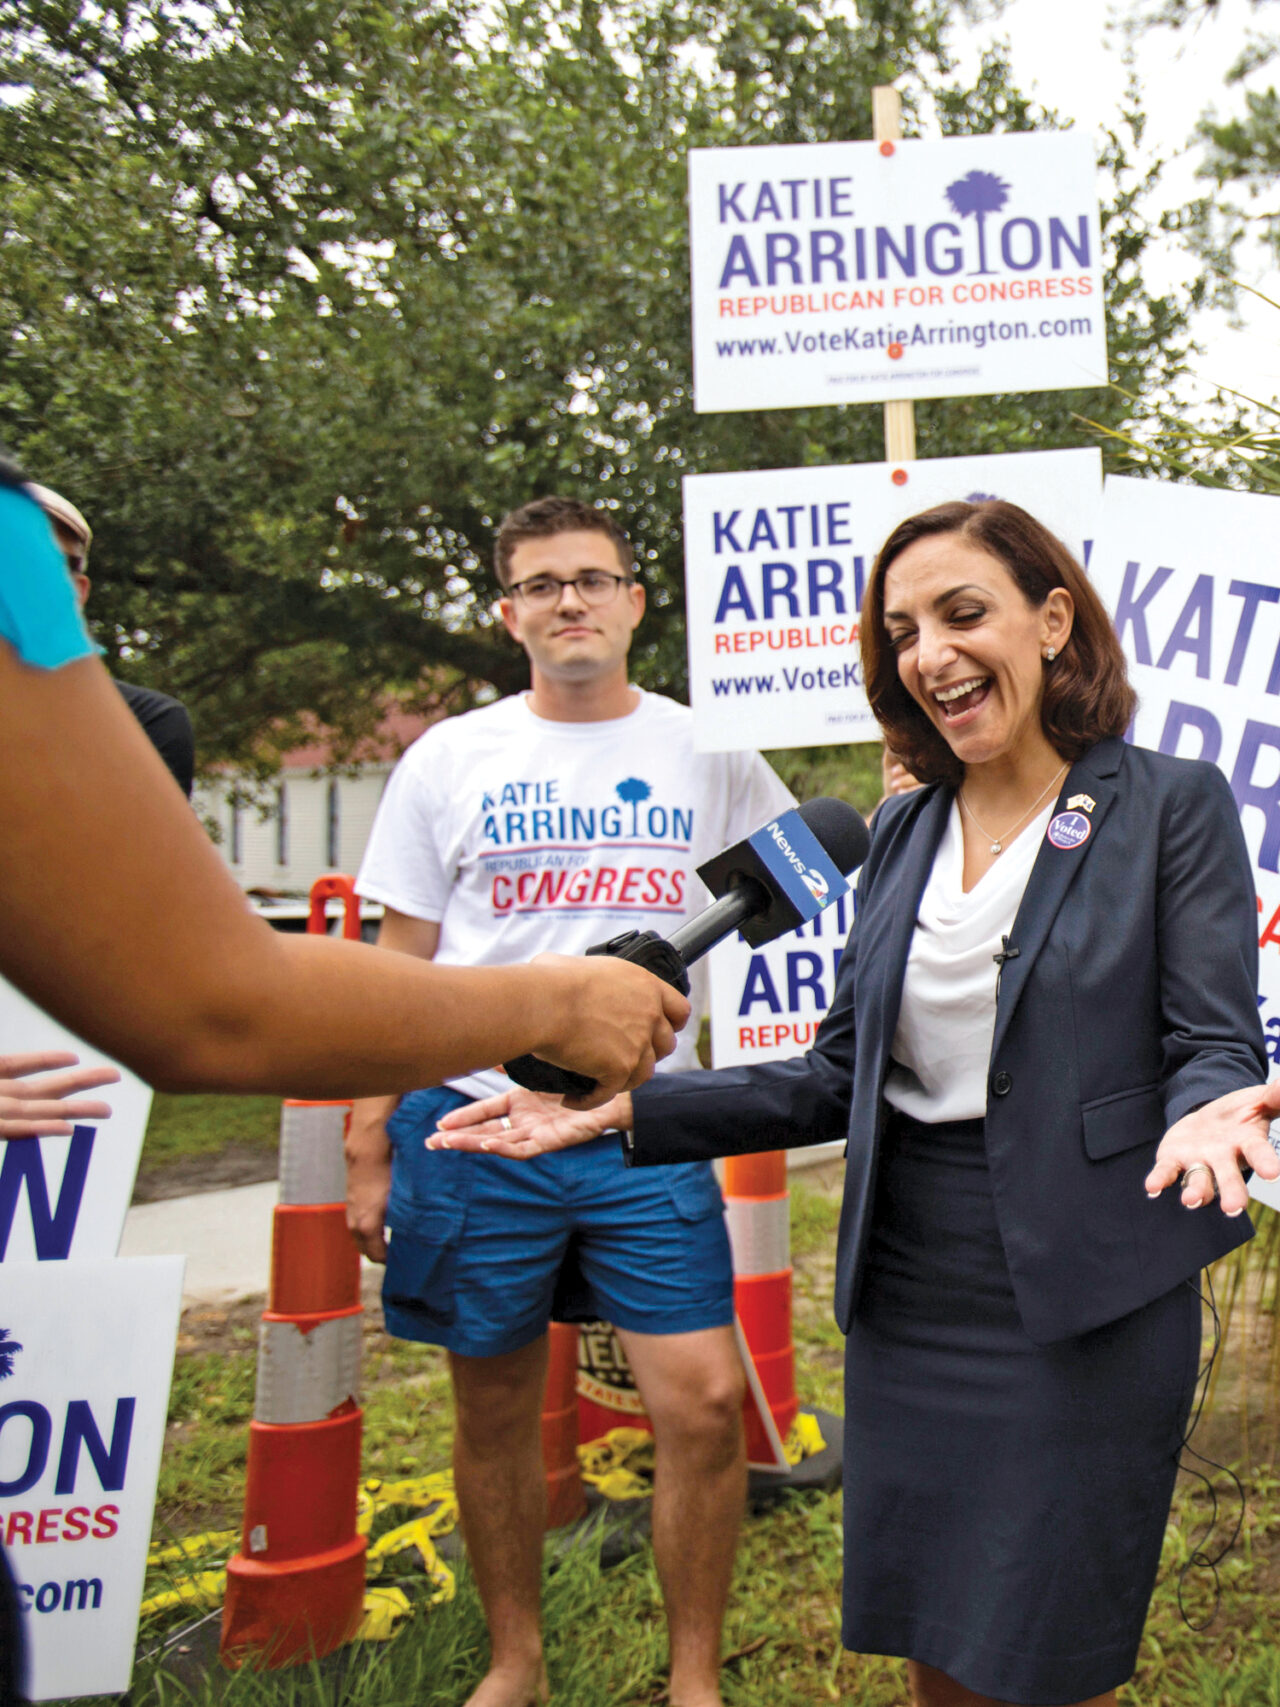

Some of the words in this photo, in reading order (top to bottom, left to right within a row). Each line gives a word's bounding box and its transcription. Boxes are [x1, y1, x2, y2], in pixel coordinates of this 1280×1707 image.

[717, 176, 854, 224] KATIE
[718, 214, 1092, 289] ARRINGTON
[719, 289, 885, 318] REPUBLICAN
[893, 286, 944, 308] FOR
[952, 276, 1094, 304] CONGRESS
[716, 317, 1093, 358] www.VoteKatieArrington.com
[712, 502, 853, 554] KATIE
[714, 554, 868, 624] ARRI
[481, 779, 559, 812] KATIE
[484, 806, 694, 845] ARRINGTON
[1054, 819, 1087, 840] Voted
[1070, 816, 1079, 826] I
[766, 822, 806, 875] News
[492, 867, 686, 910] CONGRESS
[738, 949, 844, 1016] AR
[738, 1021, 821, 1050] REPU
